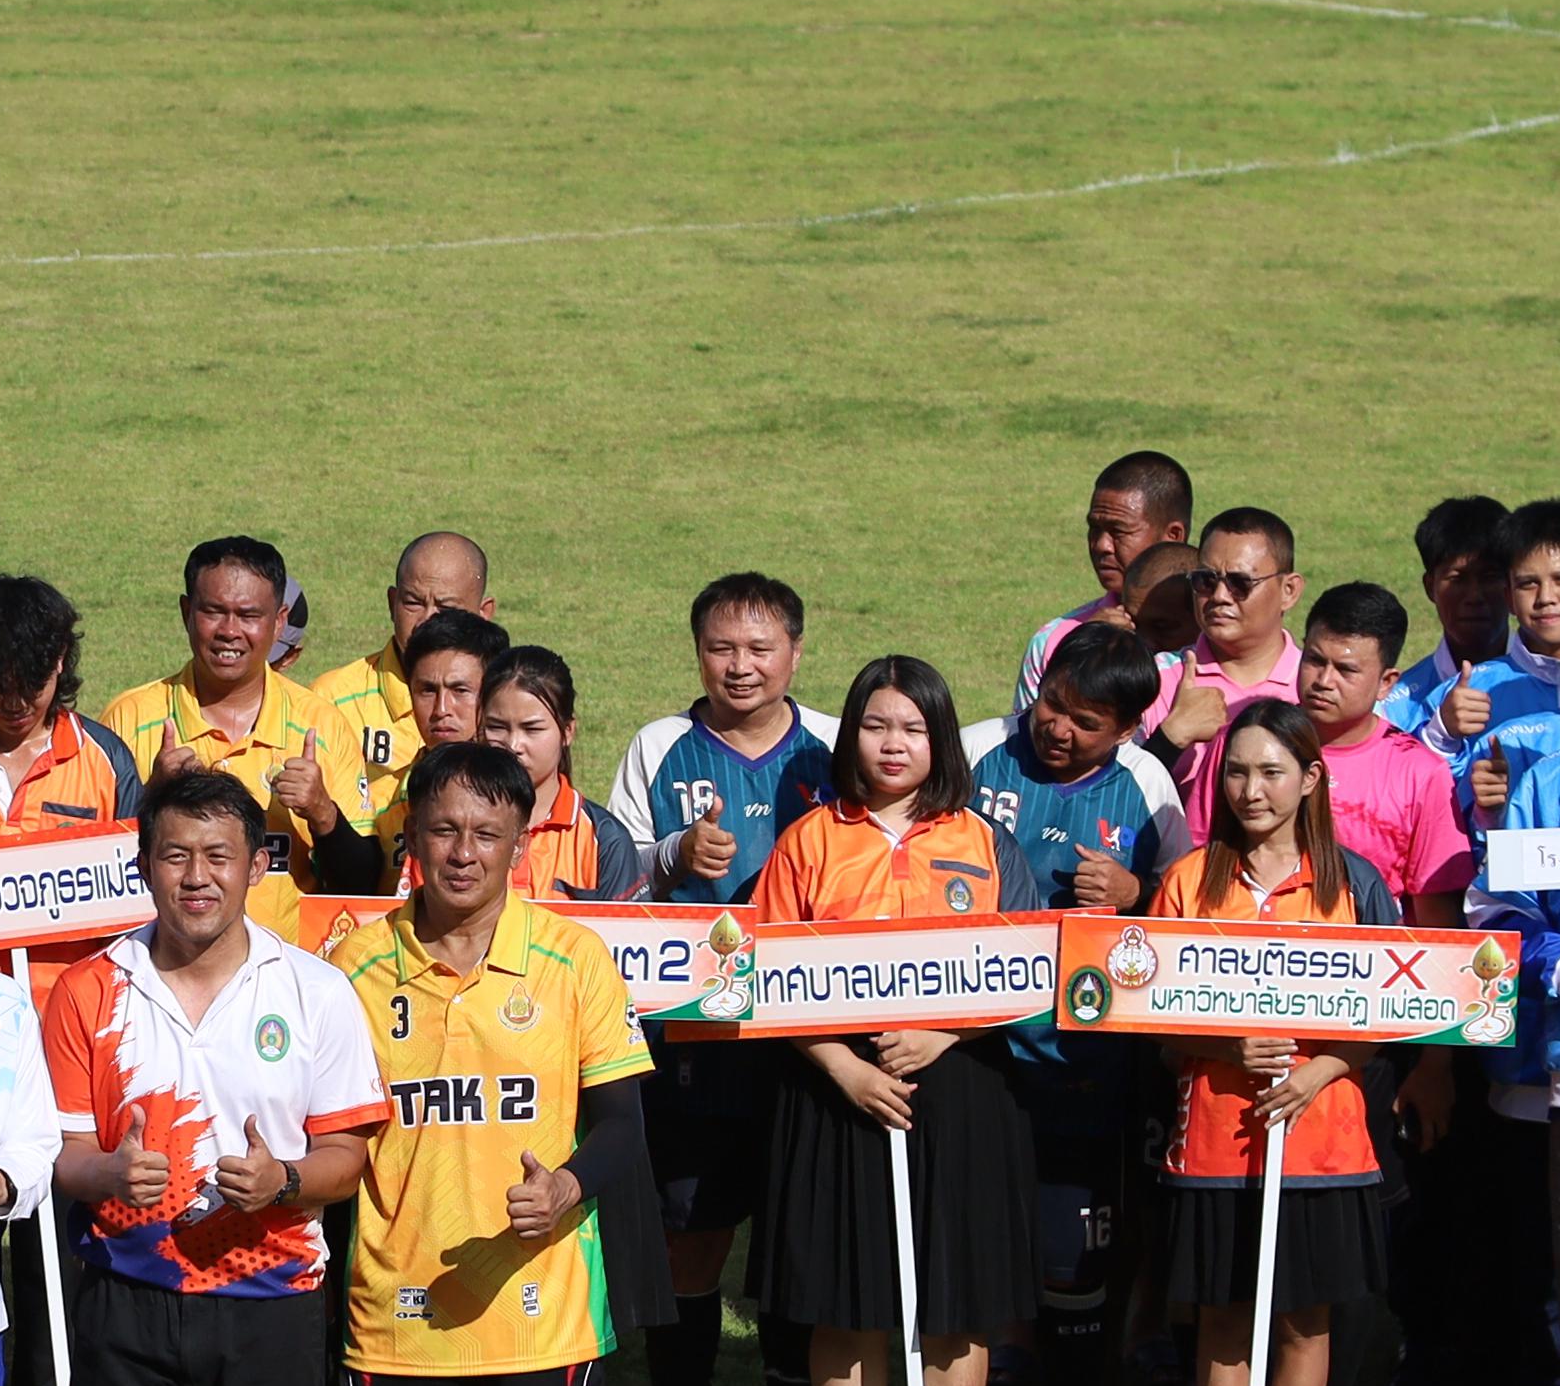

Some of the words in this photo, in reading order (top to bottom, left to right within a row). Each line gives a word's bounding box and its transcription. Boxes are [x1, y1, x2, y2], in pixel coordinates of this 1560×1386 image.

[363, 726, 392, 765] 18
[755, 945, 1054, 1004] เทศบาลนครแม่สอด
[1177, 943, 1372, 987] ศาลยุติธรรม
[390, 995, 410, 1040] 3
[1150, 986, 1369, 1027] มหาวิทยาลัยราชภัฏ
[1380, 992, 1456, 1022] แม่สอด
[389, 1076, 486, 1128] TAK
[498, 1076, 537, 1121] 2
[1058, 1321, 1102, 1337] EGO
